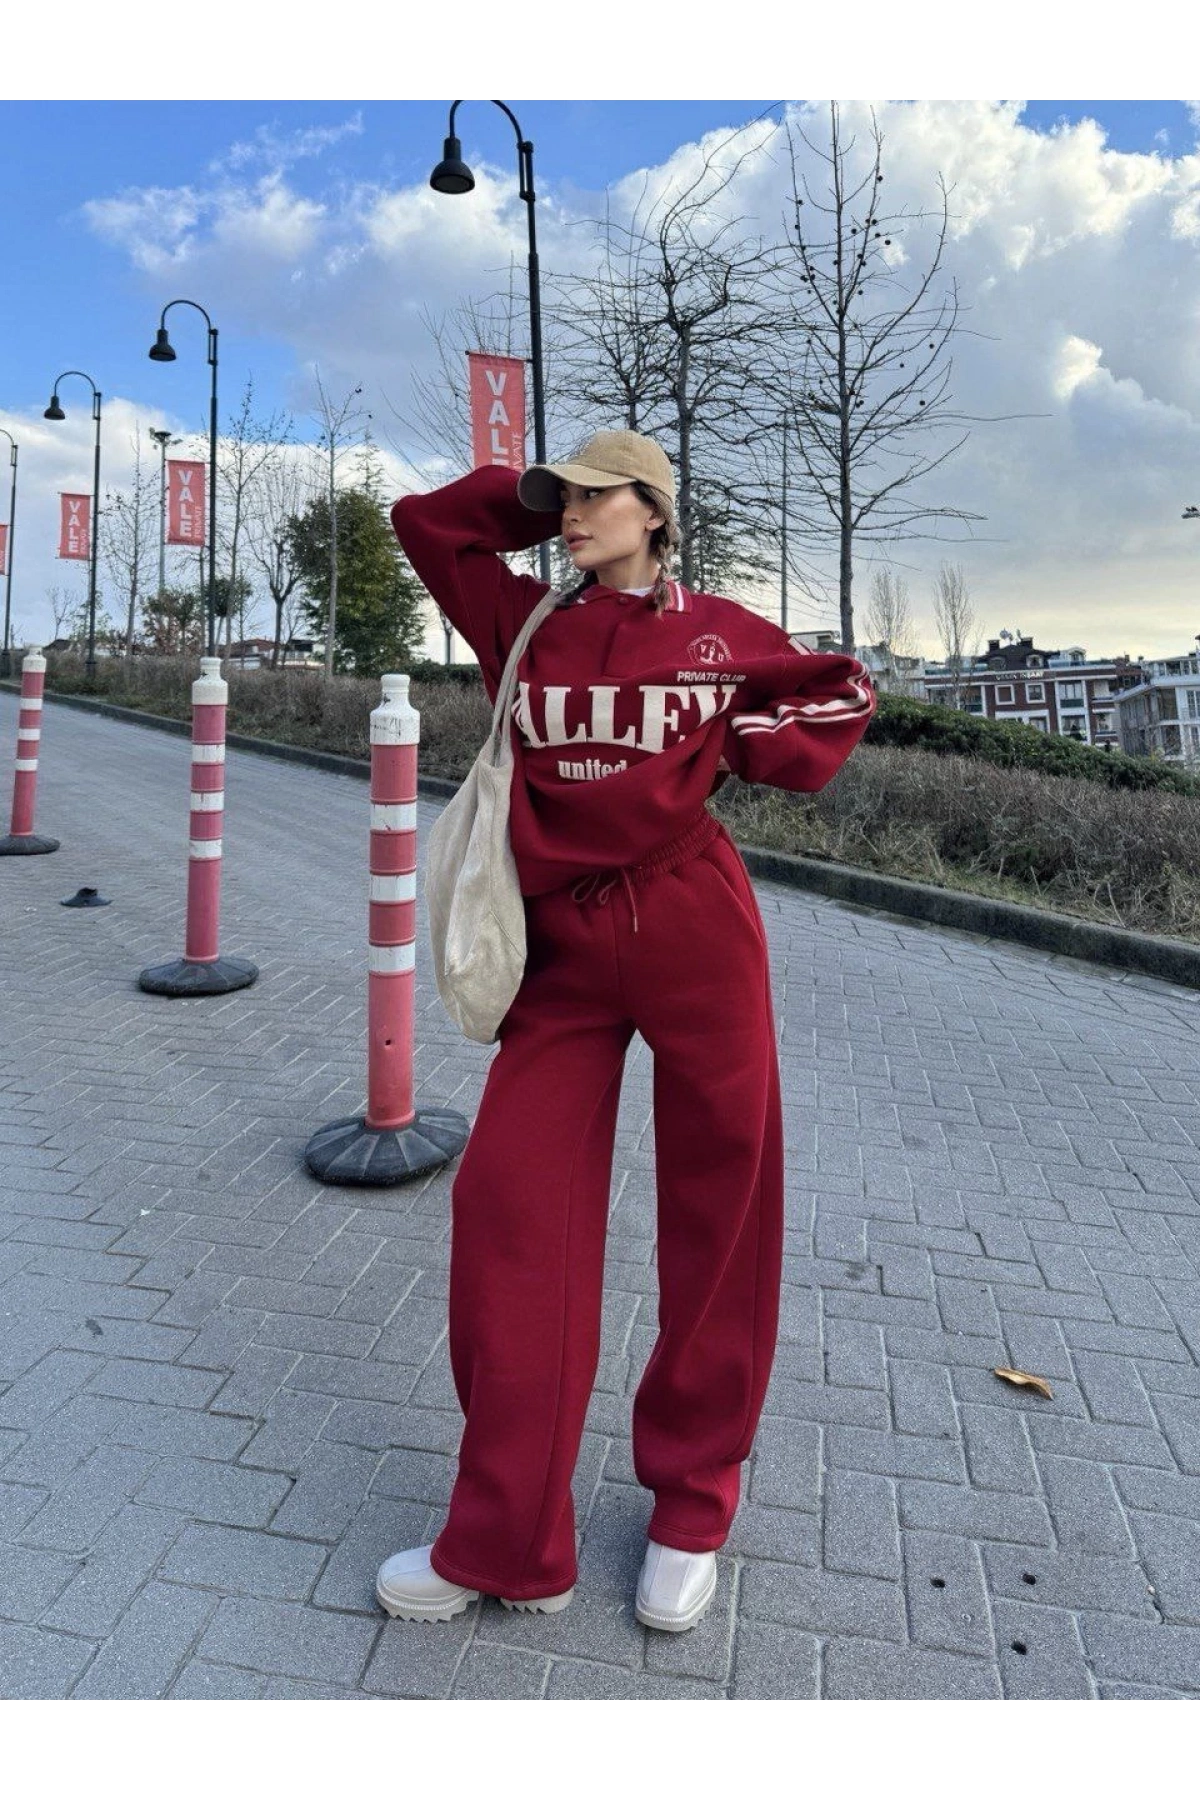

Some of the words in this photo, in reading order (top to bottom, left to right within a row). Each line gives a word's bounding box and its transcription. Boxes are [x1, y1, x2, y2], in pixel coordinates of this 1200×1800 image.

[178, 470, 194, 537] VALE
[69, 500, 81, 553] VALE
[677, 671, 719, 682] PRIVATE
[720, 673, 747, 682] CLUB
[558, 759, 627, 781] united
